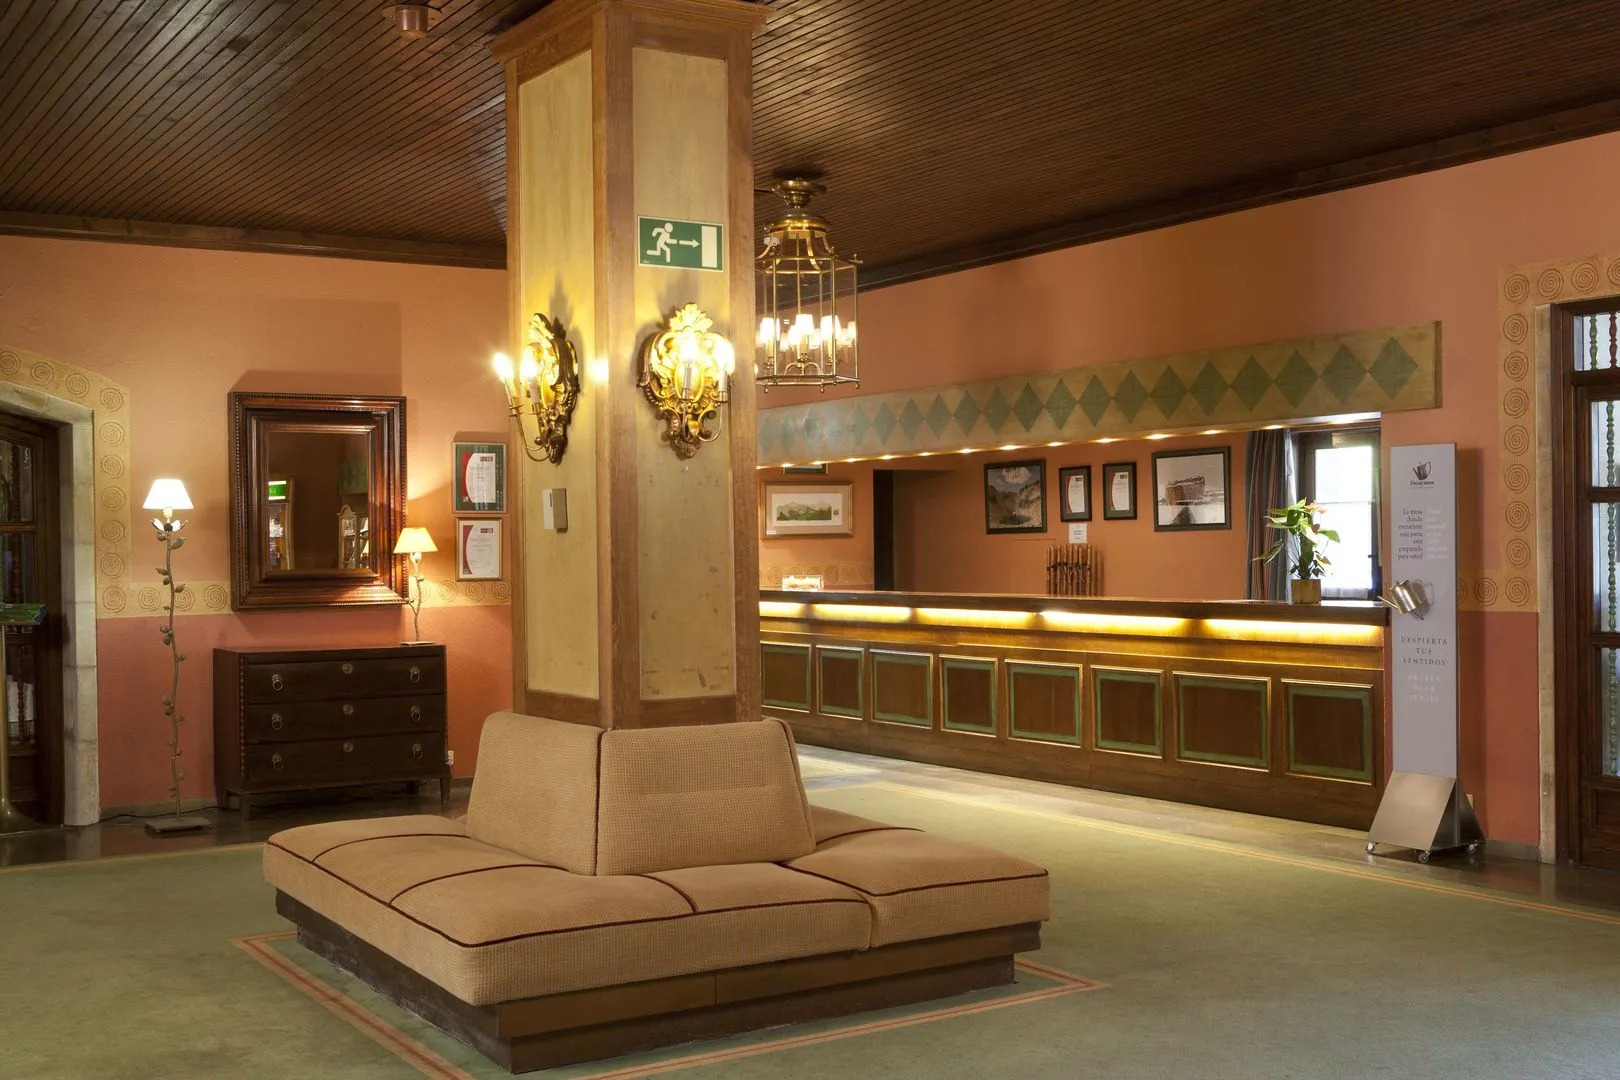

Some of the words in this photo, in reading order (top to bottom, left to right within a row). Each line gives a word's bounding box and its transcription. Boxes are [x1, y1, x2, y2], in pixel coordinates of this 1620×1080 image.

[1401, 636, 1448, 645] DESPIERTA
[1416, 647, 1432, 655] TUS
[1402, 657, 1447, 666] SENTIDOS
